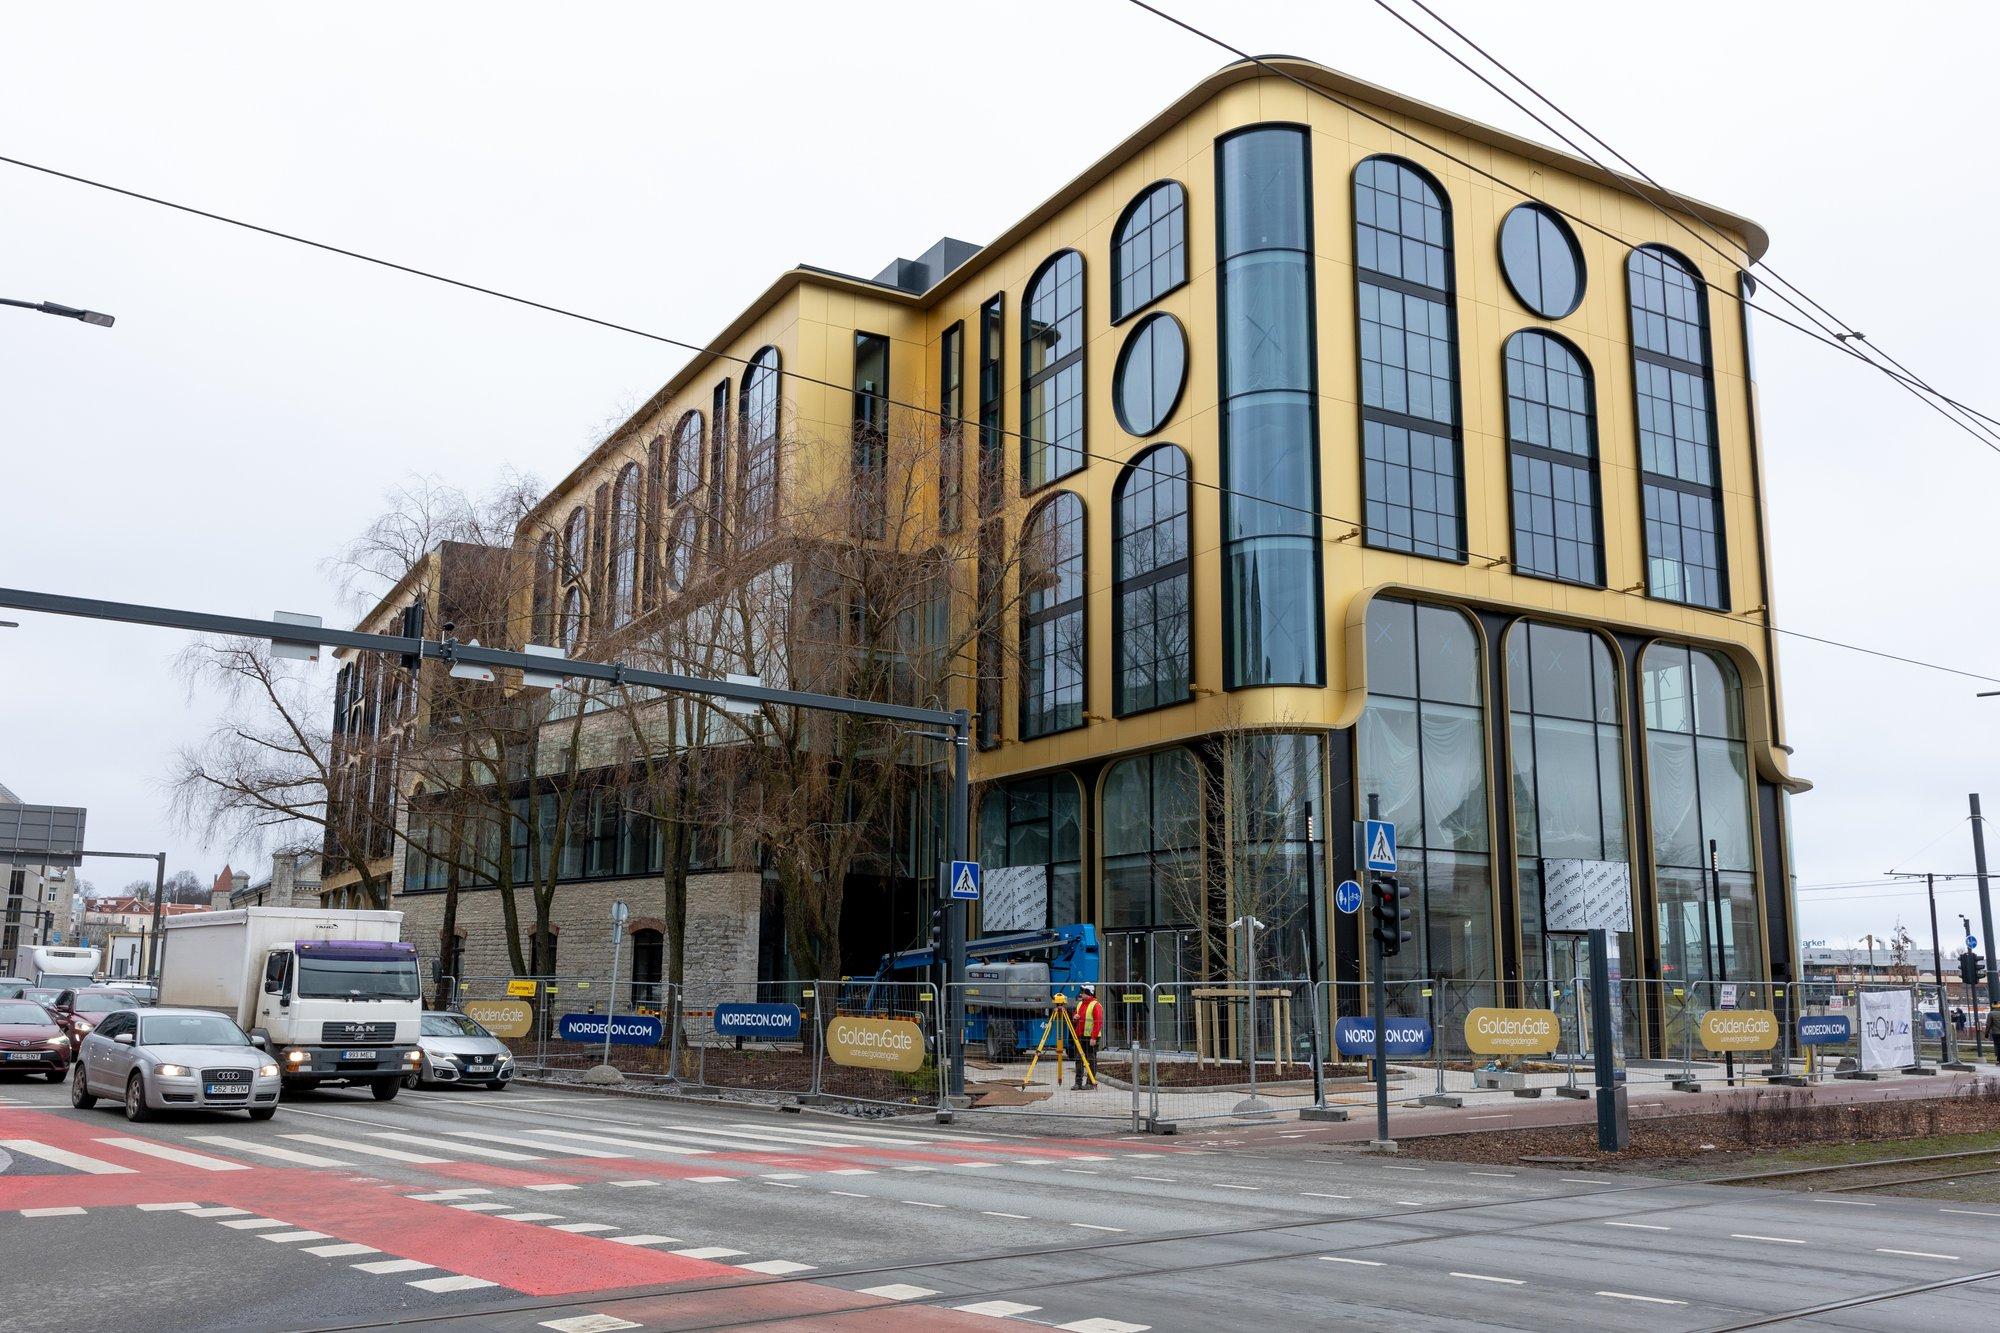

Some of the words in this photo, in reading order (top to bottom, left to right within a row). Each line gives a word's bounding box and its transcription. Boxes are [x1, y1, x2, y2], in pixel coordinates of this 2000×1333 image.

[1801, 938, 1826, 948] arket
[722, 1013, 792, 1027] NORDECON.COM
[568, 1022, 652, 1037] NORDECON.COM
[1344, 1029, 1424, 1043] NORDON.COM
[1801, 1024, 1846, 1036] NORDECON.COM
[230, 1085, 248, 1093] BYM
